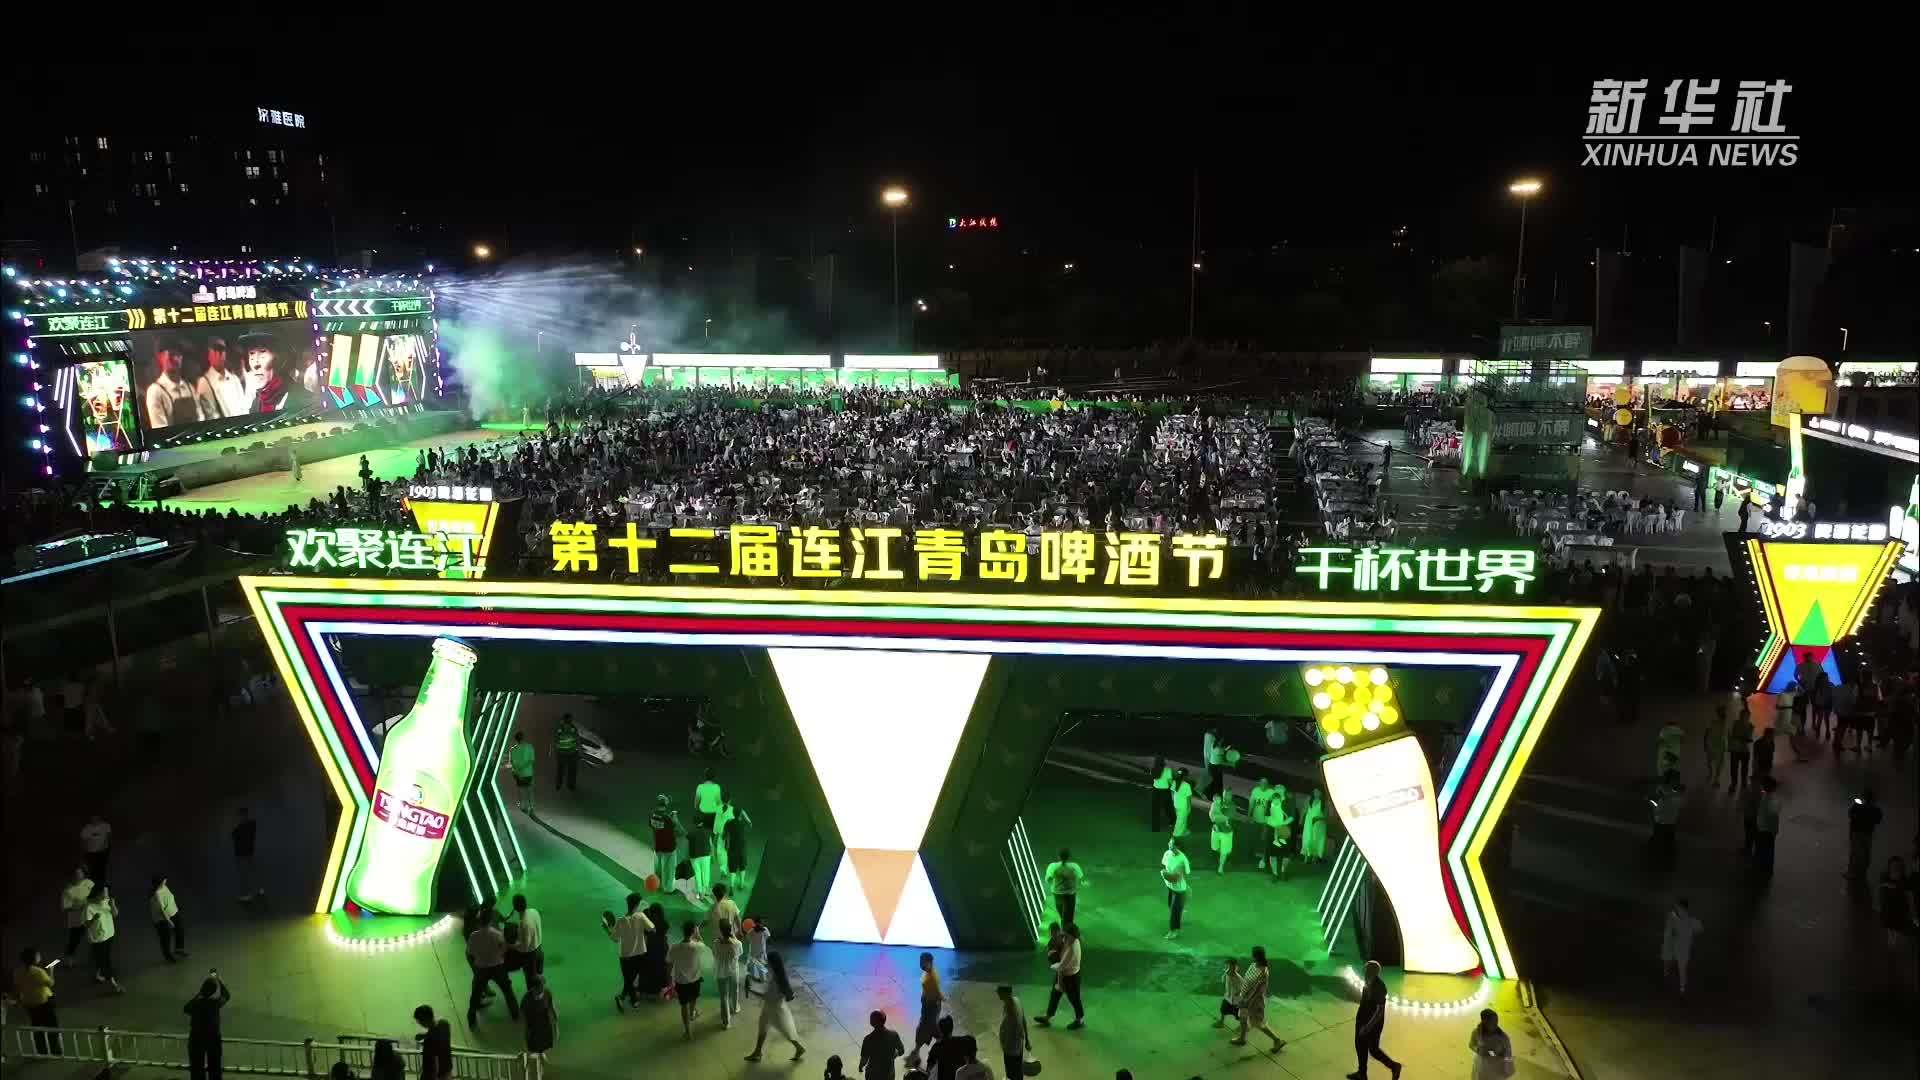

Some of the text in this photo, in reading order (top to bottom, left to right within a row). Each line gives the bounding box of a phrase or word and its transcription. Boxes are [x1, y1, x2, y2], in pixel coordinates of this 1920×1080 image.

[47, 315, 111, 332] 欢聚连江
[152, 301, 290, 325] 第十二届连江青岛啤酒节
[286, 528, 487, 573] 欢聚连江
[549, 521, 1228, 588] 第十二届连江青岛啤酒节
[1295, 547, 1537, 595] 干杯世界
[379, 791, 445, 830] TSNGTAO
